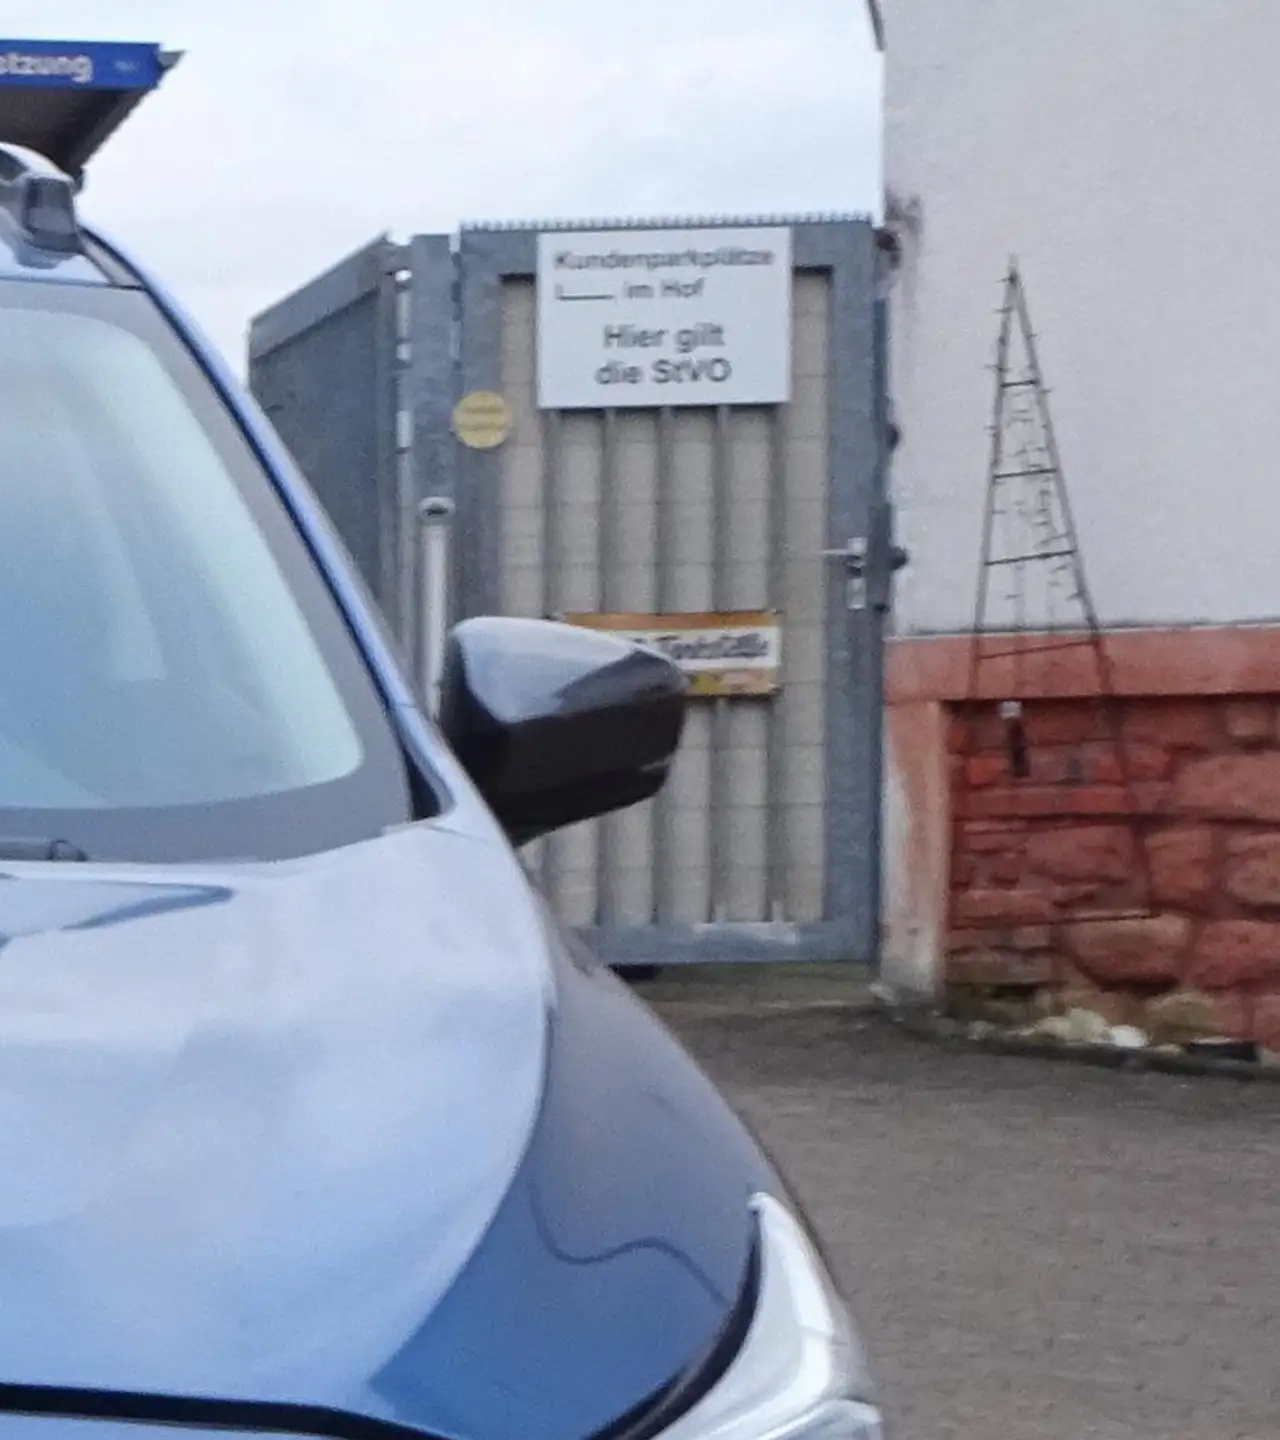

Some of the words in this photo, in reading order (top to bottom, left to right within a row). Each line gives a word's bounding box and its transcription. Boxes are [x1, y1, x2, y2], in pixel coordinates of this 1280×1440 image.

[552, 248, 775, 271] Kundenparkplätze
[623, 278, 654, 299] im
[660, 277, 706, 299] Hof
[603, 324, 668, 349] Hier
[674, 322, 726, 353] gilt
[595, 360, 641, 386] die
[651, 357, 733, 385] StVO
